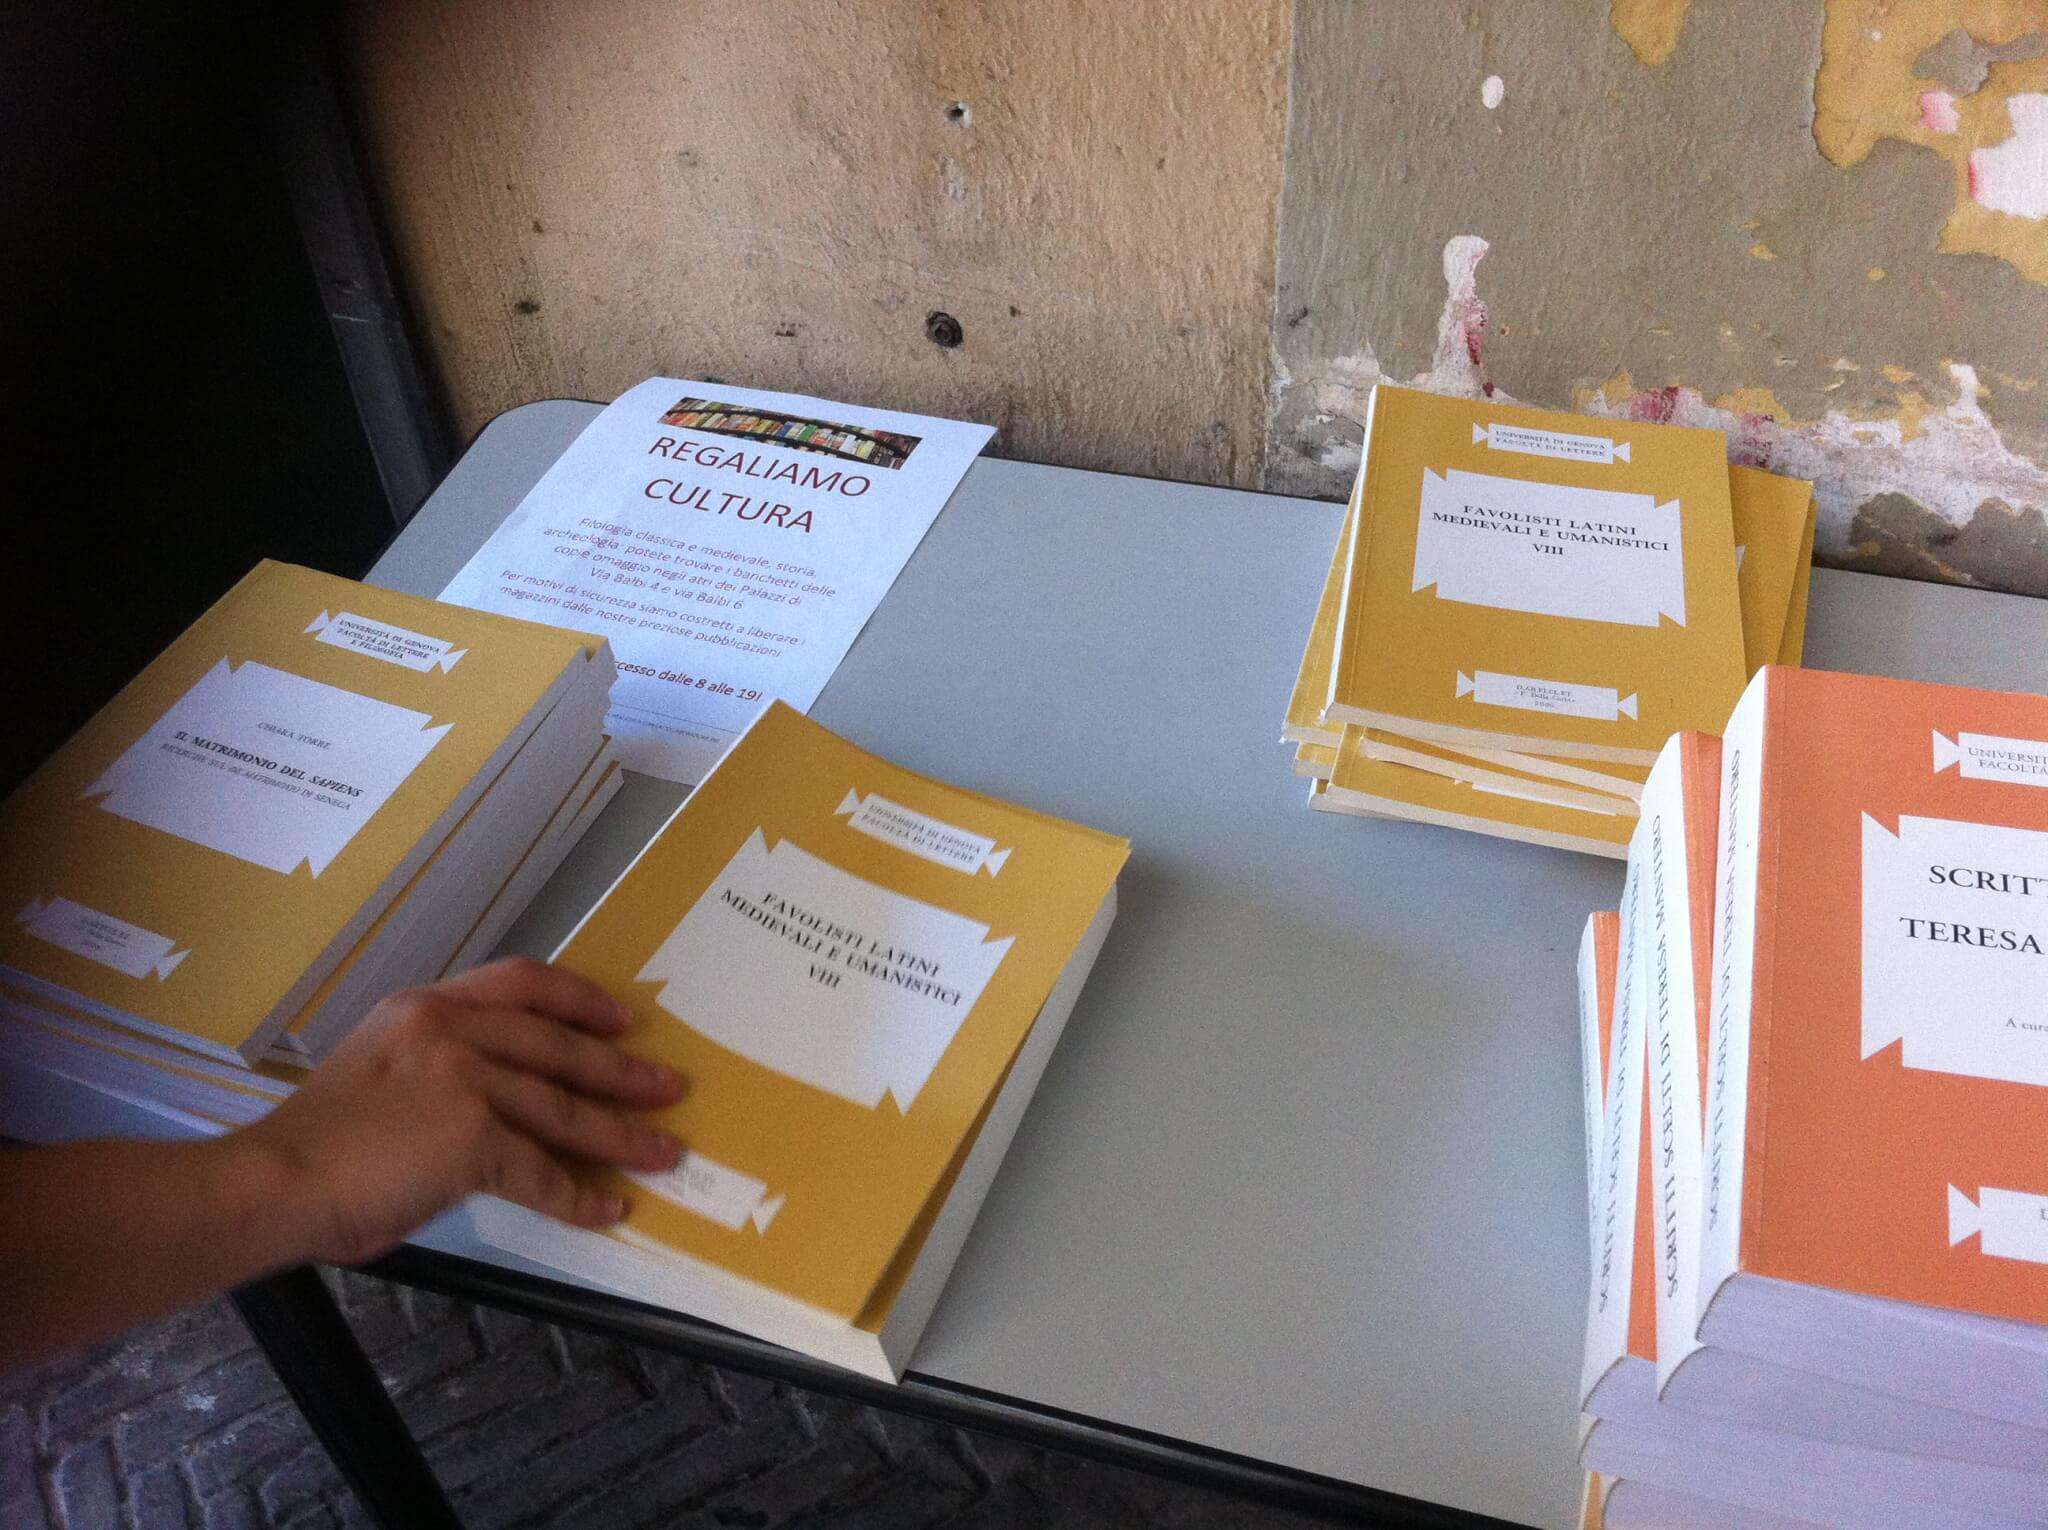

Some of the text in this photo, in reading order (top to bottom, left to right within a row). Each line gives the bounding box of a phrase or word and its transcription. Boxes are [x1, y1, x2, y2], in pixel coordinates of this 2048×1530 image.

[648, 436, 871, 498] REGALIAMO
[643, 477, 815, 534] CULTURA
[1432, 511, 1671, 551] MEDIEVALI E UMANISTICI
[1464, 504, 1637, 536] FAVOLISTI LATINI
[579, 518, 633, 537] Filologia
[635, 529, 685, 549] classica
[688, 543, 697, 551] e
[1531, 543, 1565, 556] VIII
[554, 545, 802, 606] copie omaggio negli atri dei Palazzi di
[590, 567, 744, 610] Via Balbi 4 e via Balbi 6
[624, 545, 672, 562] potete
[674, 555, 723, 574] trovare
[733, 566, 799, 590] banchetti
[801, 583, 836, 597] delle
[499, 586, 782, 658] magazzini dalle nostre preziose pubblicazioni
[501, 569, 523, 581] Per
[523, 575, 563, 590] motivi
[565, 583, 578, 595] di
[579, 588, 637, 609] sicurezza
[639, 603, 678, 619] siamo
[679, 612, 733, 631] costretti
[736, 625, 745, 635] a
[747, 626, 799, 646] liberare
[614, 660, 656, 677] cesso
[658, 670, 694, 687] dalle
[695, 678, 708, 689] 8
[707, 682, 735, 697] alle
[174, 730, 364, 798] IL MATRIMONIO DEL SAPIENS
[721, 888, 964, 1007] MEDIEVALI E UMANISTICI
[762, 891, 941, 978] FAVOLISTI LATINI
[1899, 917, 2046, 955] TERESA
[808, 963, 843, 990] VIII
[2005, 1017, 2017, 1028] A
[1652, 815, 1678, 1299] SCRITTI SCELTI DI TERESA MANTERO
